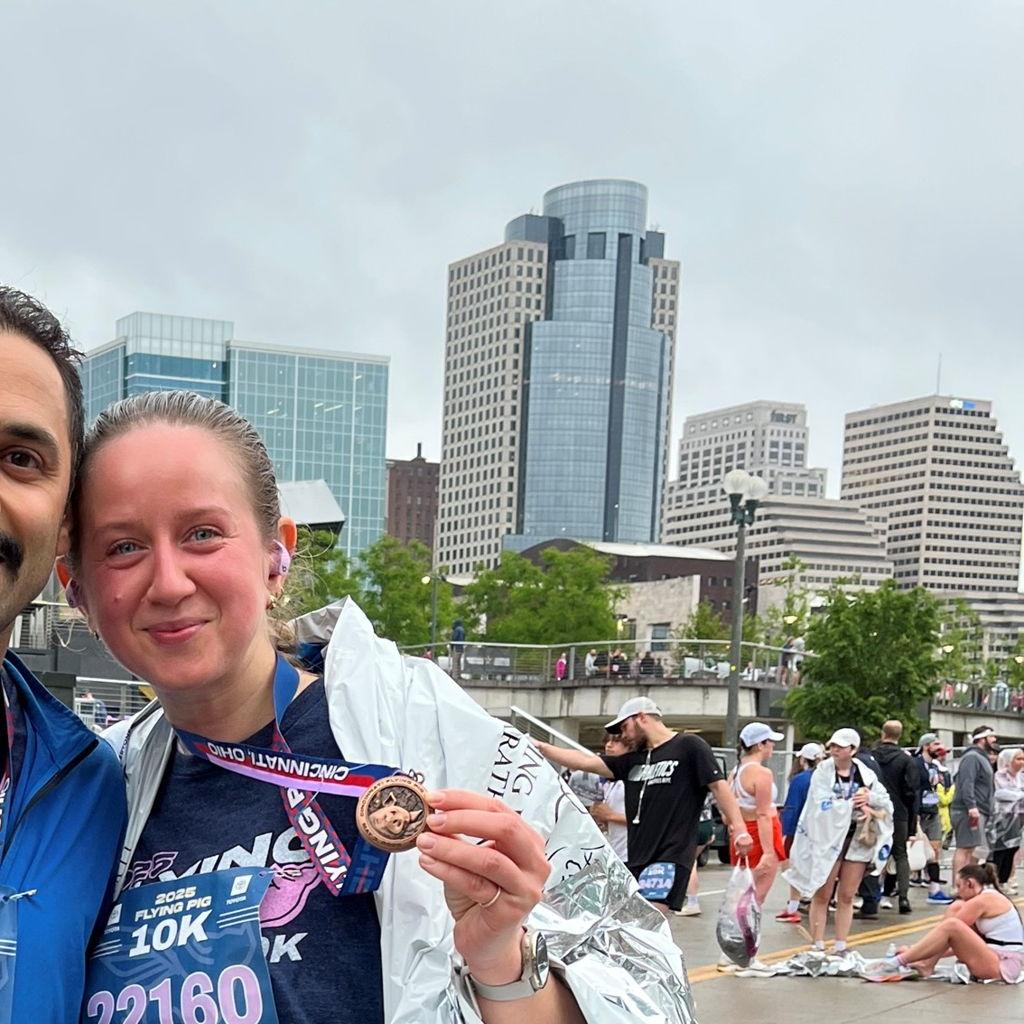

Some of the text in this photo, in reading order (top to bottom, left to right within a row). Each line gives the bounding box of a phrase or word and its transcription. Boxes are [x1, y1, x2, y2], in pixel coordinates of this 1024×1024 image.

[207, 742, 246, 763] OHIO
[154, 886, 197, 905] 2025
[134, 895, 213, 922] FLYING PIG
[128, 909, 213, 958] 10K
